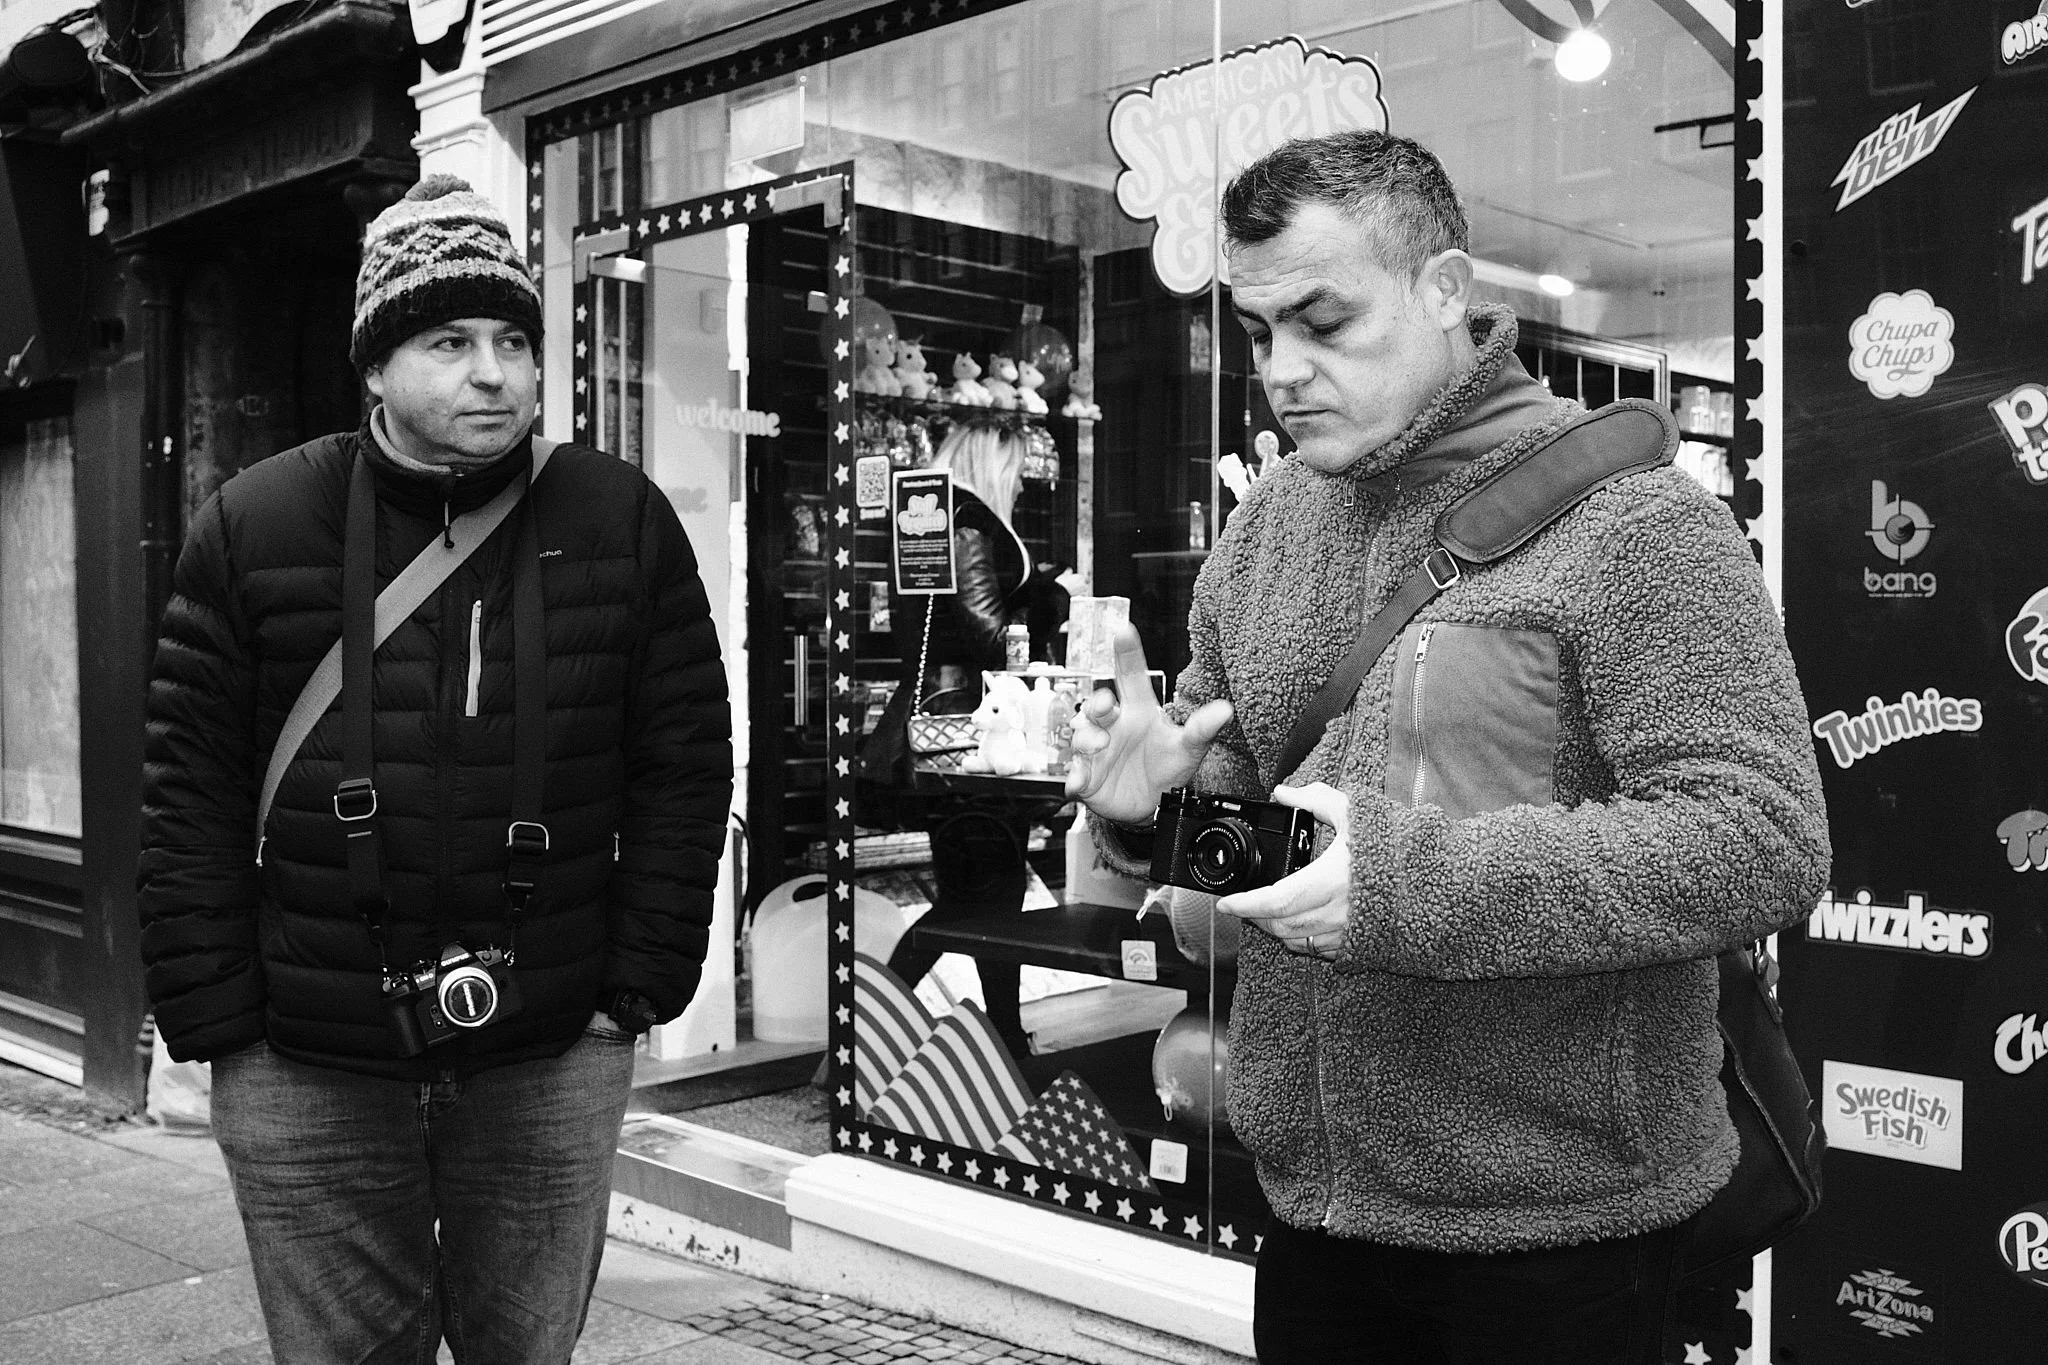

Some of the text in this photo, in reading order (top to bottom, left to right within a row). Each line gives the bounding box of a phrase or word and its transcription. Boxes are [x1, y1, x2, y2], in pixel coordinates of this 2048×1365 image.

[1866, 319, 1939, 346] Chupa
[1862, 343, 1935, 382] Chups
[676, 398, 781, 438] welcome
[1863, 566, 1937, 598] bang
[1817, 692, 1978, 764] Twinkies
[1836, 1082, 1948, 1127] Swedish
[1860, 1109, 1924, 1146] Fish
[1835, 1280, 1934, 1323] AriZona
